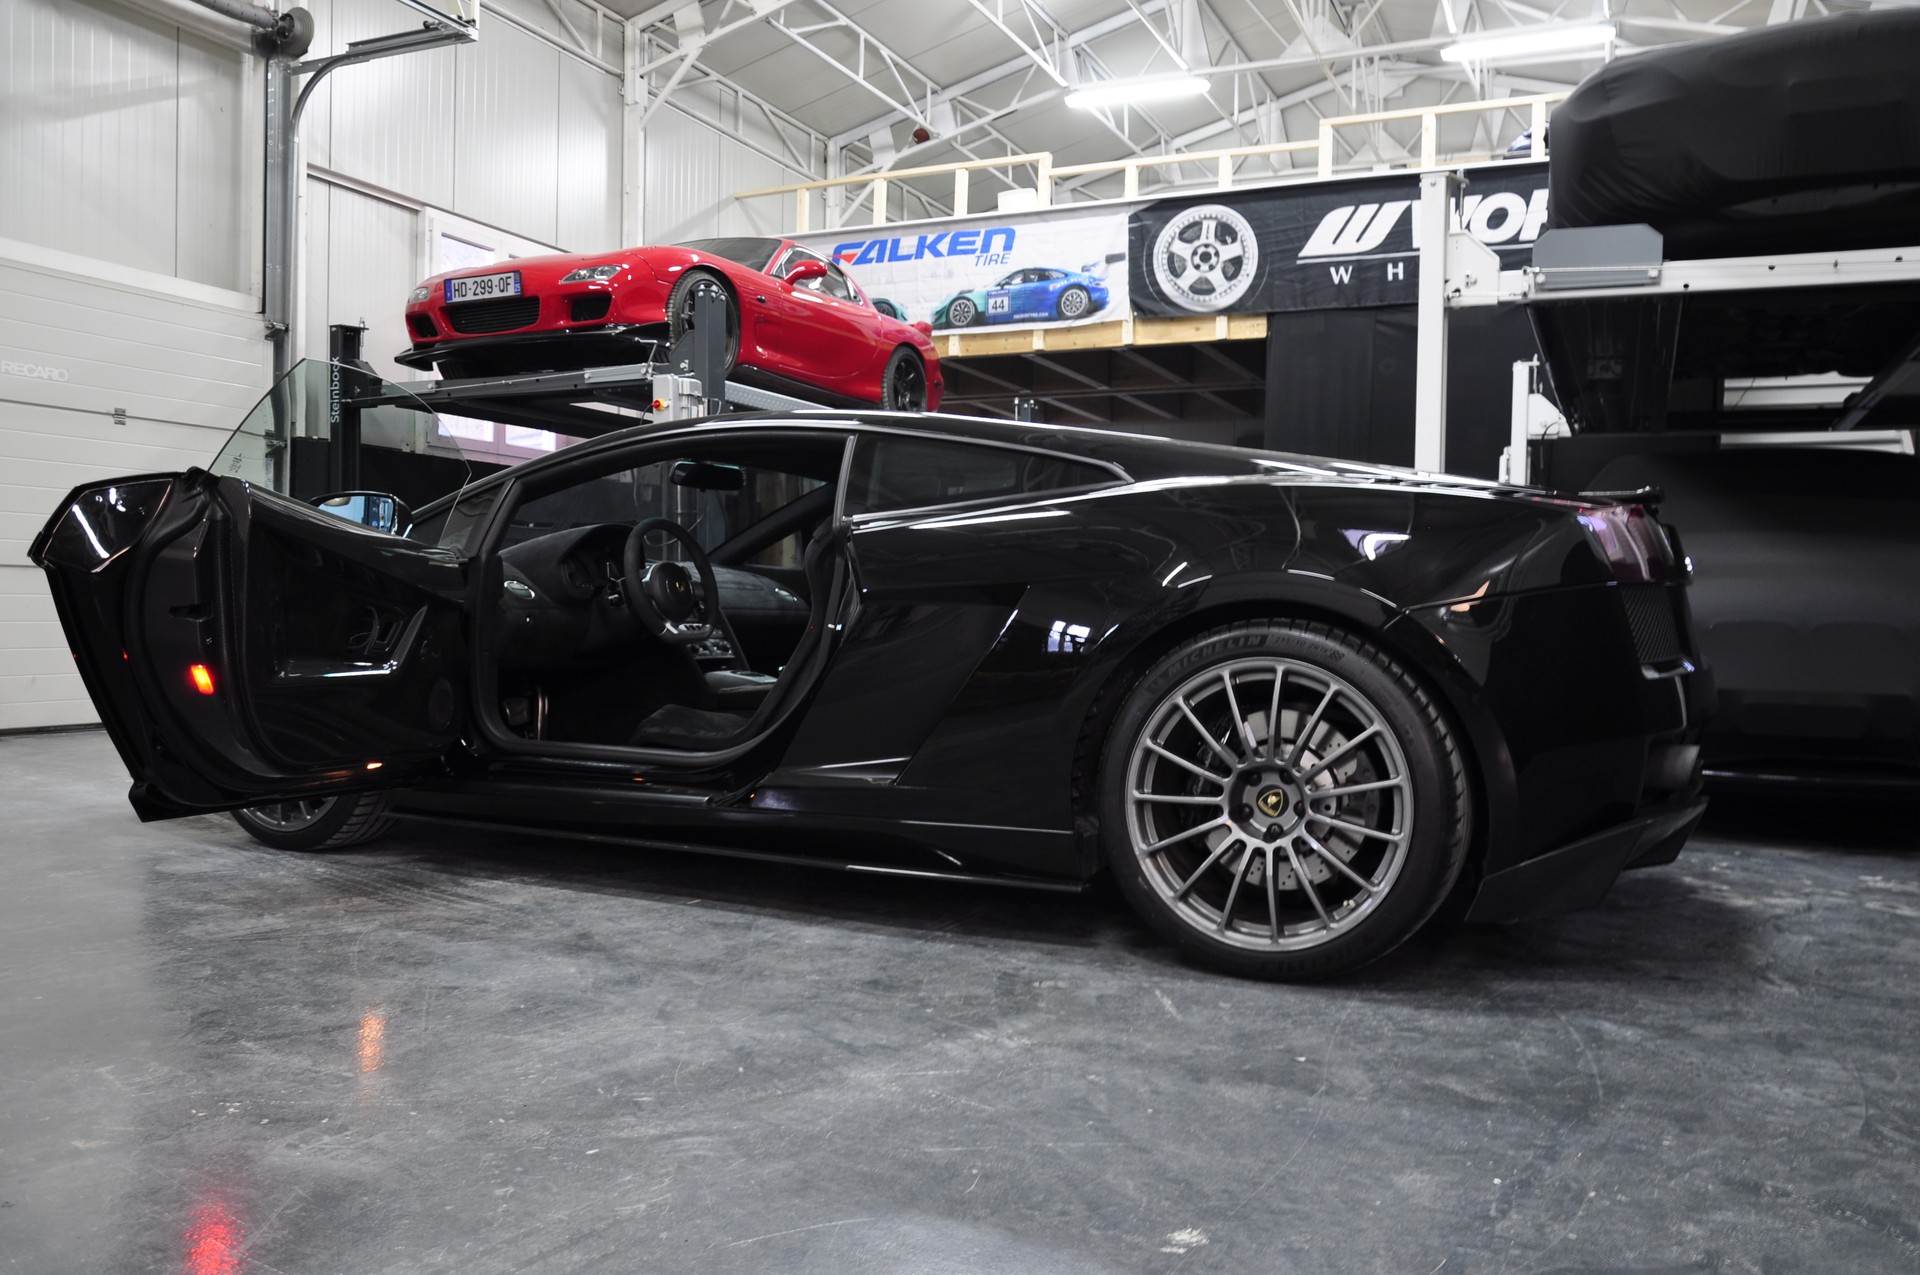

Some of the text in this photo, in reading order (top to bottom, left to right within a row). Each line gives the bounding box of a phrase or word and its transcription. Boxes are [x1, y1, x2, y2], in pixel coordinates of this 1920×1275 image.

[830, 227, 1016, 266] FALKEN
[974, 253, 1011, 267] TIRE
[453, 275, 512, 299] HD-299-QF
[991, 299, 1005, 312] 44
[1, 360, 69, 381] RECARO
[330, 356, 340, 423] Steinbock
[1168, 635, 1262, 679] MICHELIN
